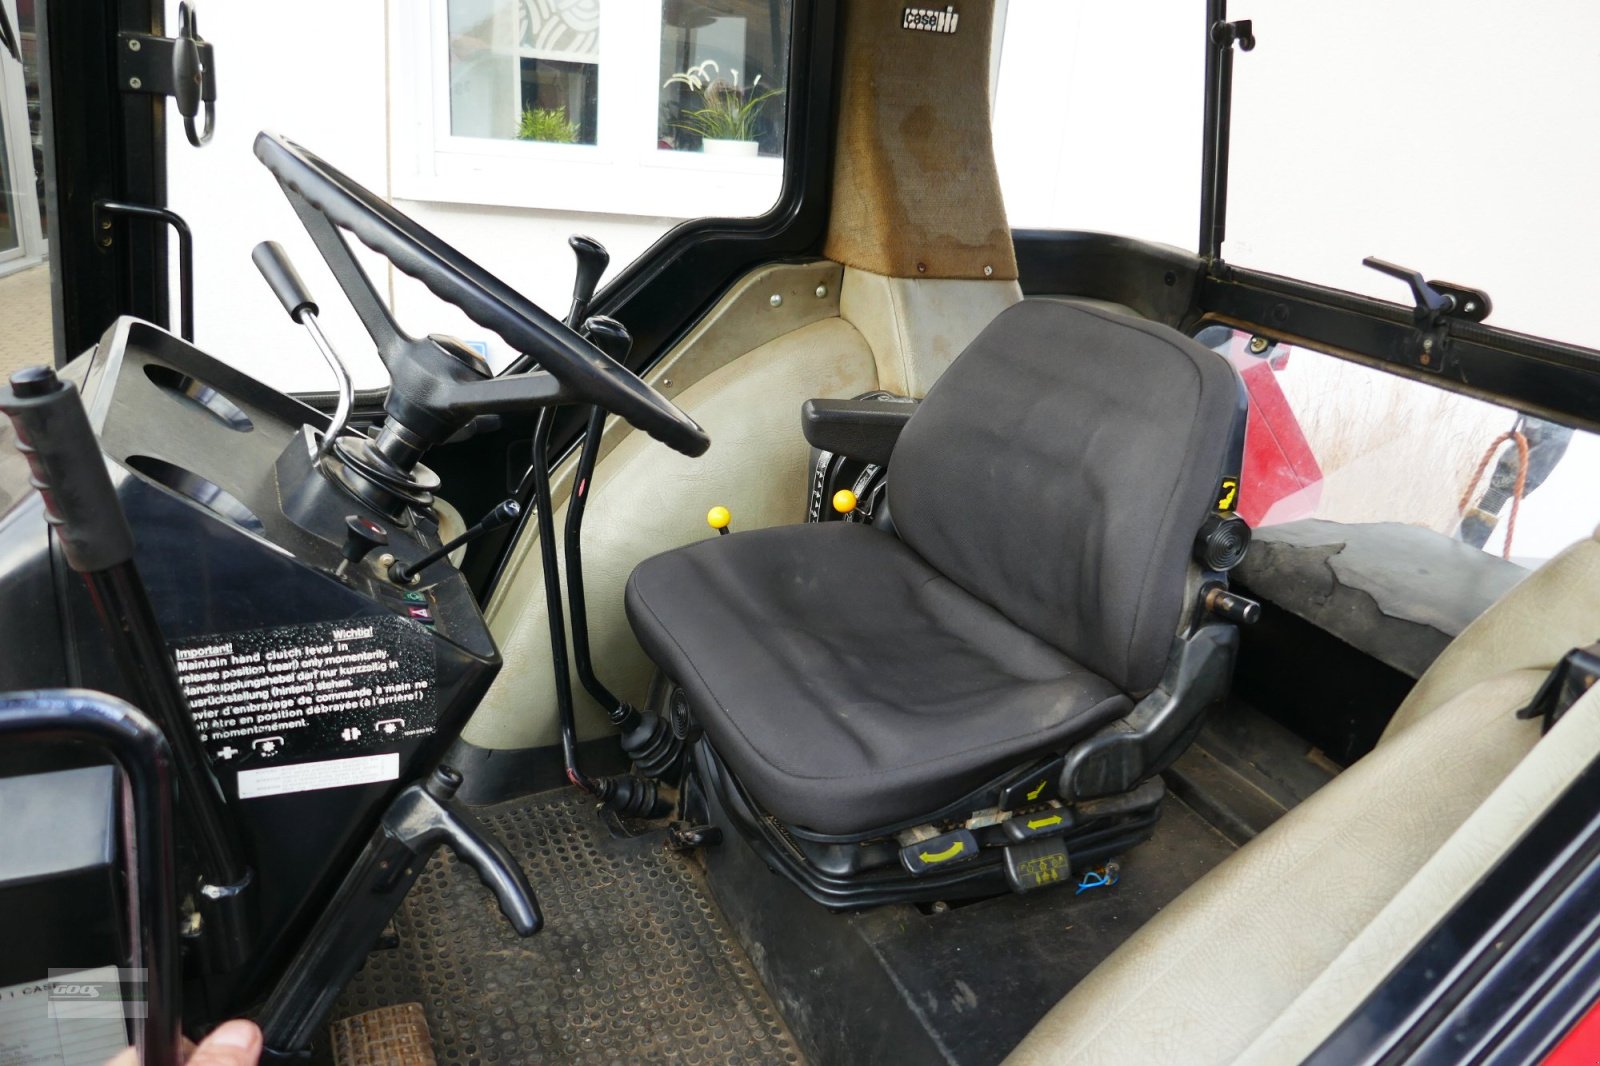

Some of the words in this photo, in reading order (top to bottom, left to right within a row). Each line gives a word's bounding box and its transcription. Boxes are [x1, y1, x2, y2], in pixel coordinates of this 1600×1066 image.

[332, 626, 373, 641] Wichtig!
[176, 643, 233, 660] Important!
[177, 658, 227, 672] Maintain
[231, 652, 260, 664] hand
[265, 648, 302, 661] clutch
[305, 642, 333, 655] lever
[337, 643, 348, 651] in
[179, 671, 219, 684] release
[222, 666, 265, 679] position
[301, 657, 323, 668] only
[325, 650, 389, 664] momentarily.
[297, 670, 318, 681] darf
[320, 668, 337, 678] nur
[339, 661, 387, 675] kurzzeitig
[389, 660, 399, 668] in
[189, 690, 269, 708] usrückstellung
[316, 679, 353, 691] stehen.
[222, 698, 294, 716] d'embrayage
[297, 695, 312, 705] de
[316, 687, 372, 702] commande
[376, 685, 382, 694] à
[386, 682, 411, 693] main
[415, 681, 428, 689] ne
[212, 718, 236, 728] être
[239, 716, 253, 725] en
[257, 709, 304, 723] position
[306, 701, 358, 715] débrayée
